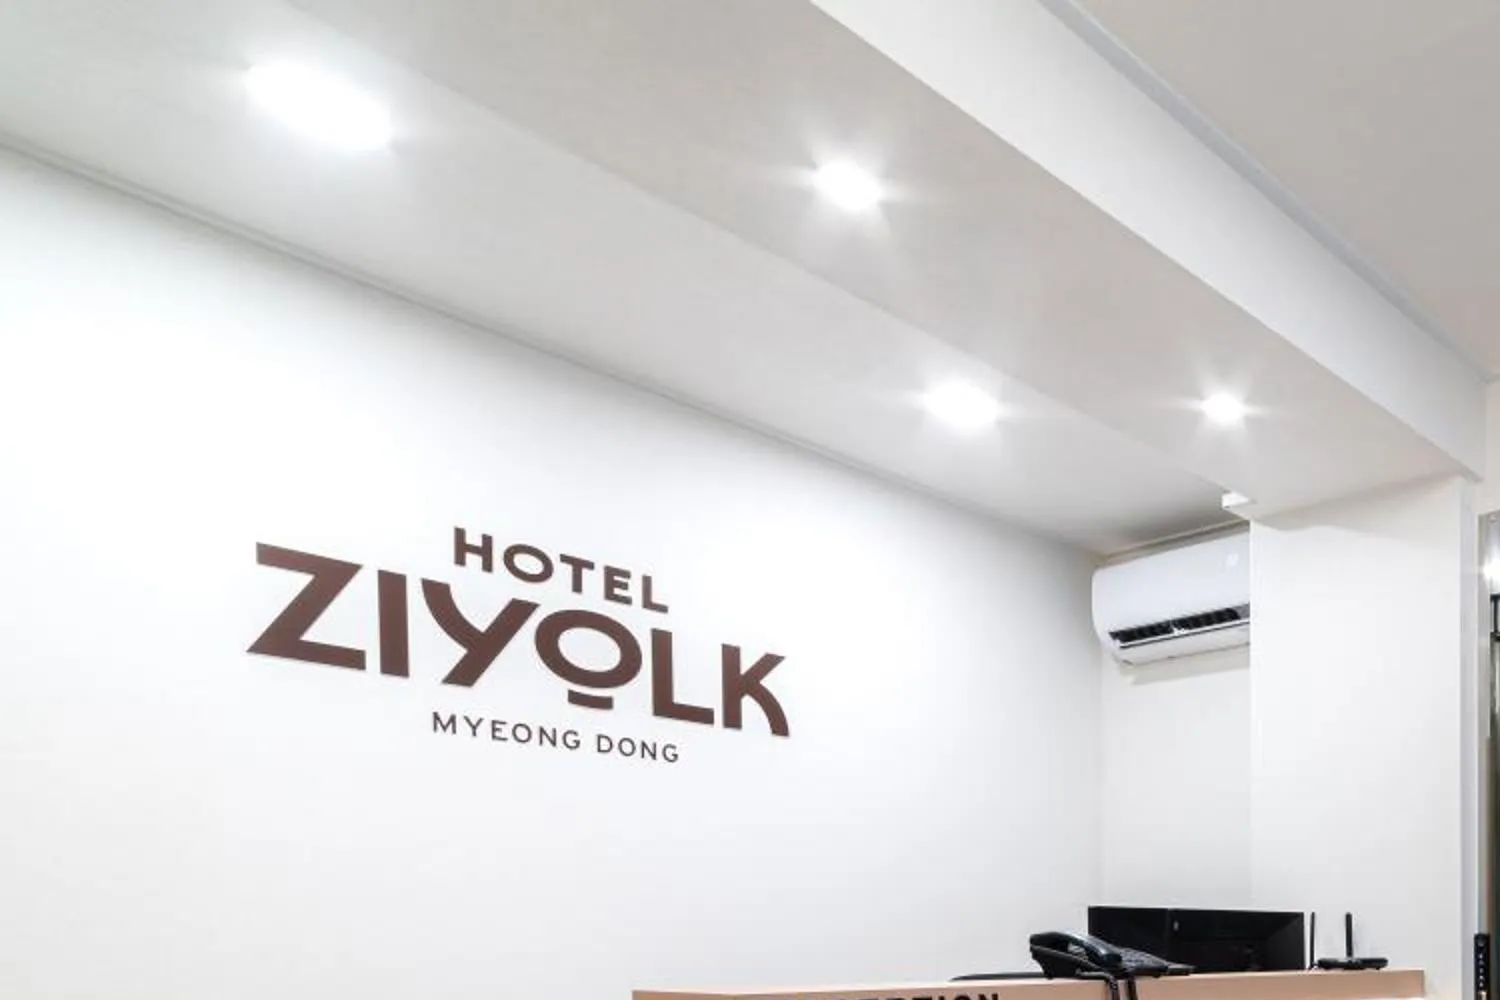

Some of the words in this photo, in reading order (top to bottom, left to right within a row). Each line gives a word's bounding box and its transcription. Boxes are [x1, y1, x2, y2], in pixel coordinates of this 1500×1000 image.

[453, 526, 669, 614] HOTEL
[245, 541, 791, 738] ZIYOLK
[431, 711, 581, 751] MYEONG
[596, 733, 680, 764] DONG
